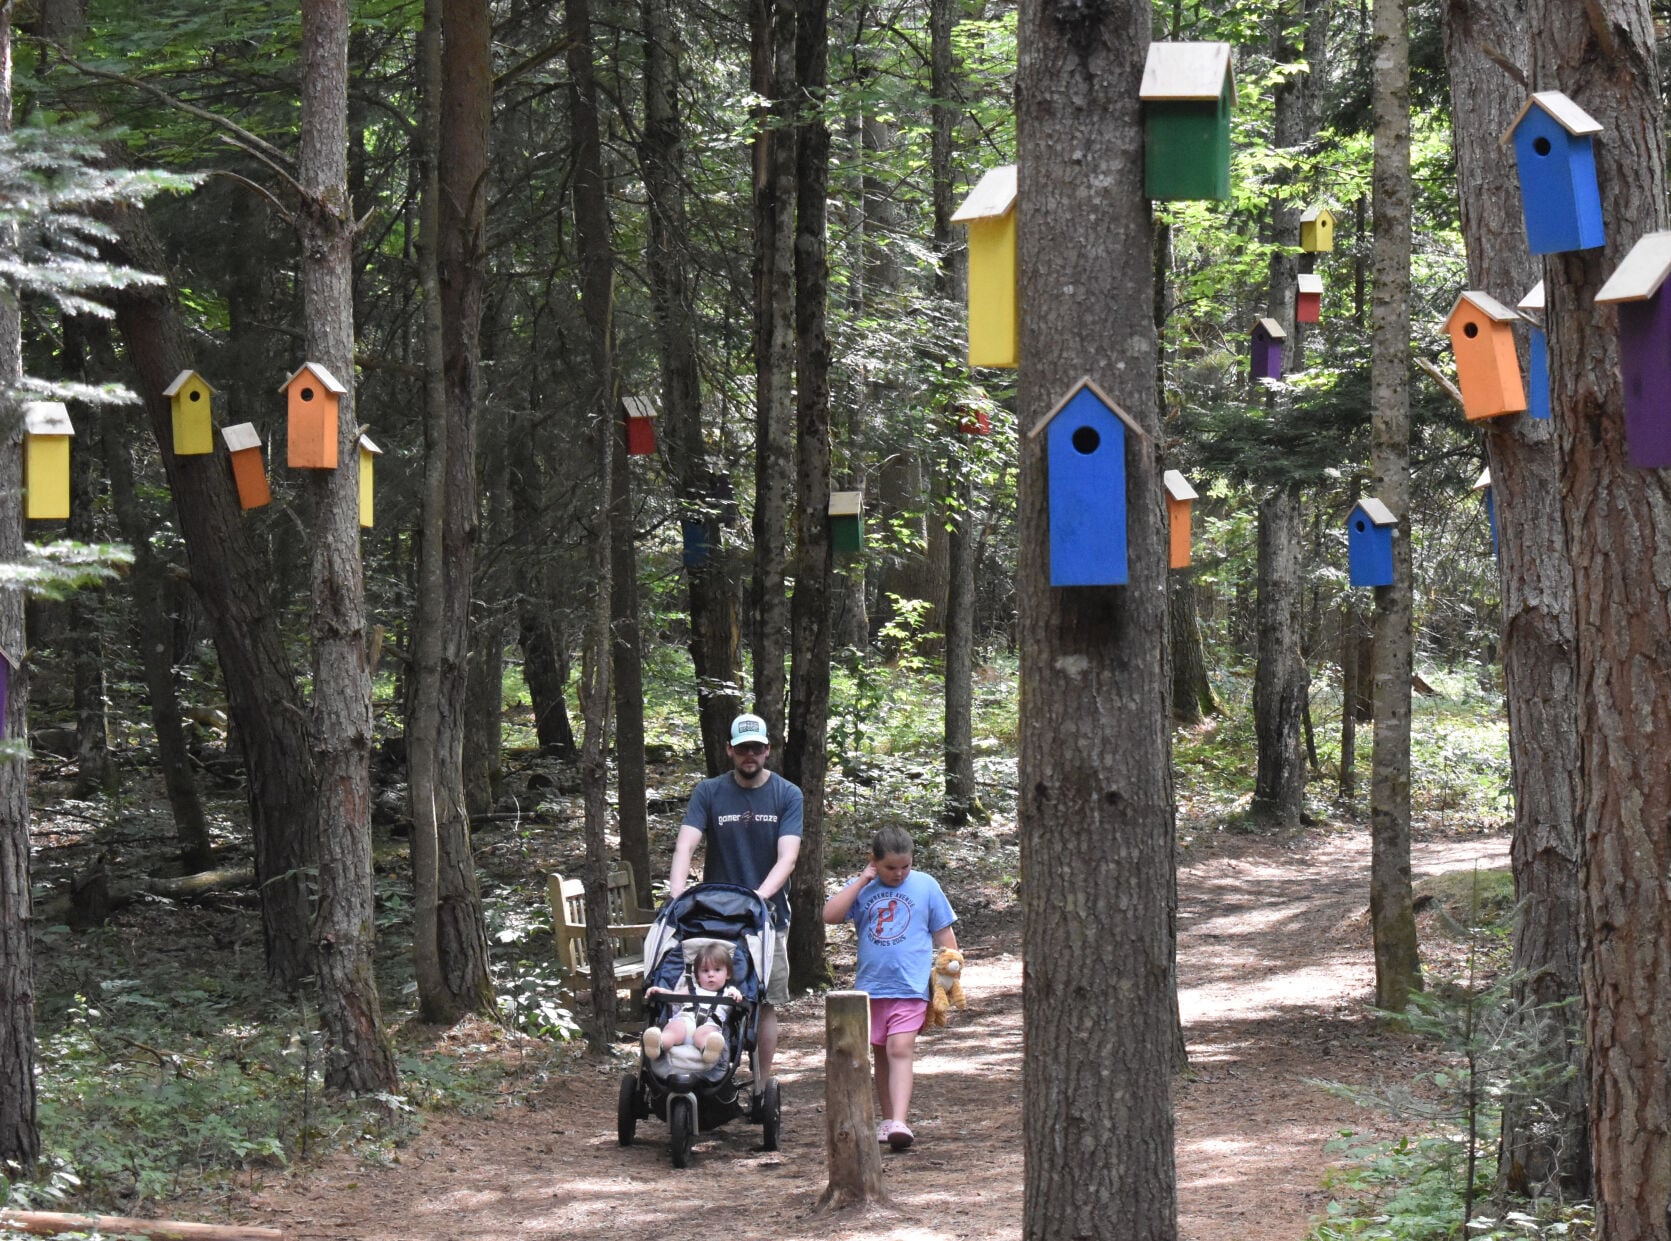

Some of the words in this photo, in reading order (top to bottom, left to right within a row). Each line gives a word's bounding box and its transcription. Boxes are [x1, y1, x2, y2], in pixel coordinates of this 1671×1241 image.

[718, 814, 742, 825] gamer
[754, 814, 778, 823] craze
[864, 891, 894, 910] LAWRENCE
[895, 892, 915, 907] AVENUE
